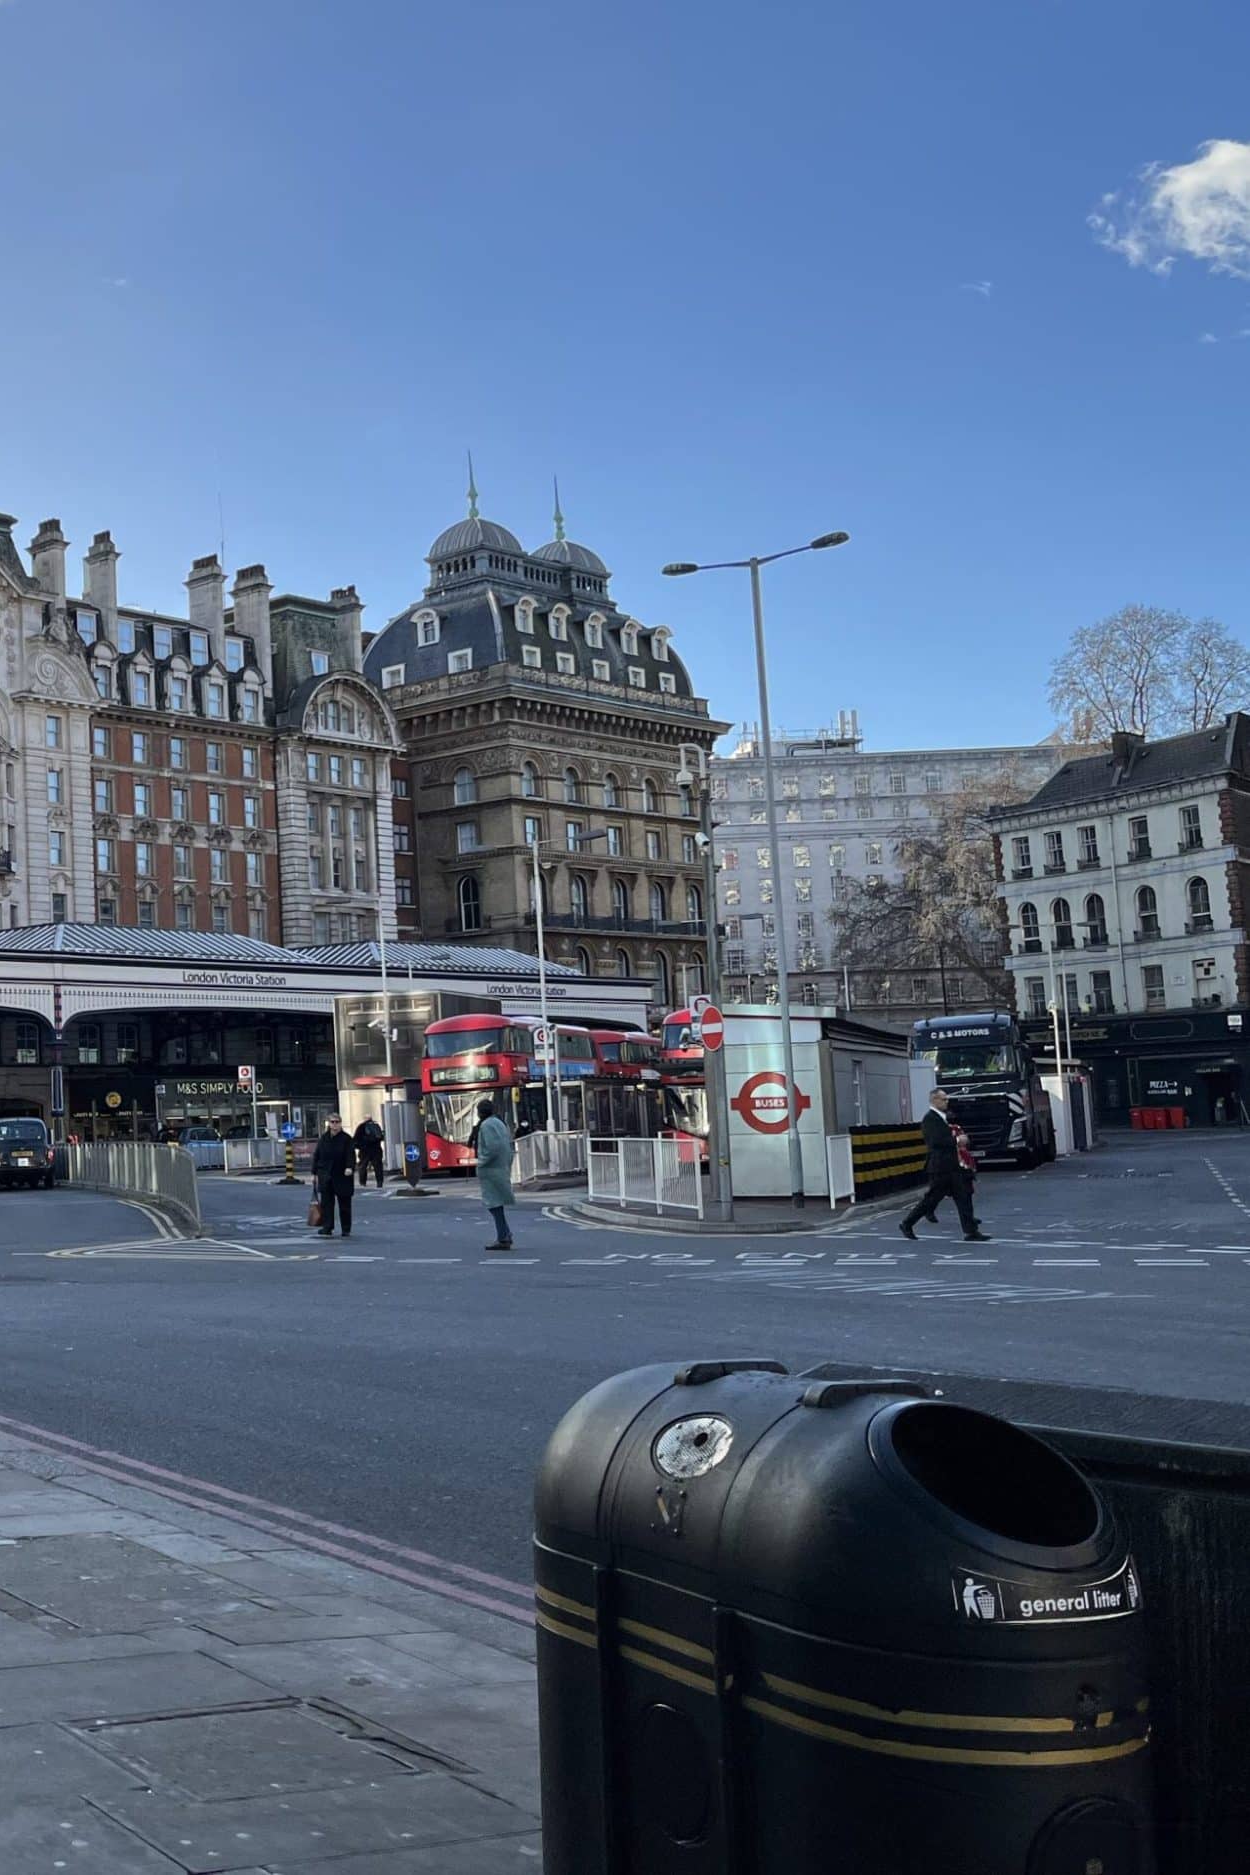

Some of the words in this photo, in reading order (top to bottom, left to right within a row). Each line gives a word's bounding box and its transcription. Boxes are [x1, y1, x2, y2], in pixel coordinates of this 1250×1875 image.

[182, 970, 218, 983] London
[220, 972, 254, 985] Victoria
[255, 973, 287, 985] Station
[486, 983, 514, 994] London
[954, 1028, 990, 1037] MOTORS
[176, 1083, 198, 1094] M&S
[200, 1082, 234, 1094] SIMPLY
[1149, 1080, 1168, 1088] PIZZA
[755, 1098, 785, 1108] BUSES
[602, 1252, 694, 1260] NO
[734, 1252, 973, 1260] ENTRY
[1019, 1591, 1090, 1617] general
[1093, 1589, 1122, 1609] litter
